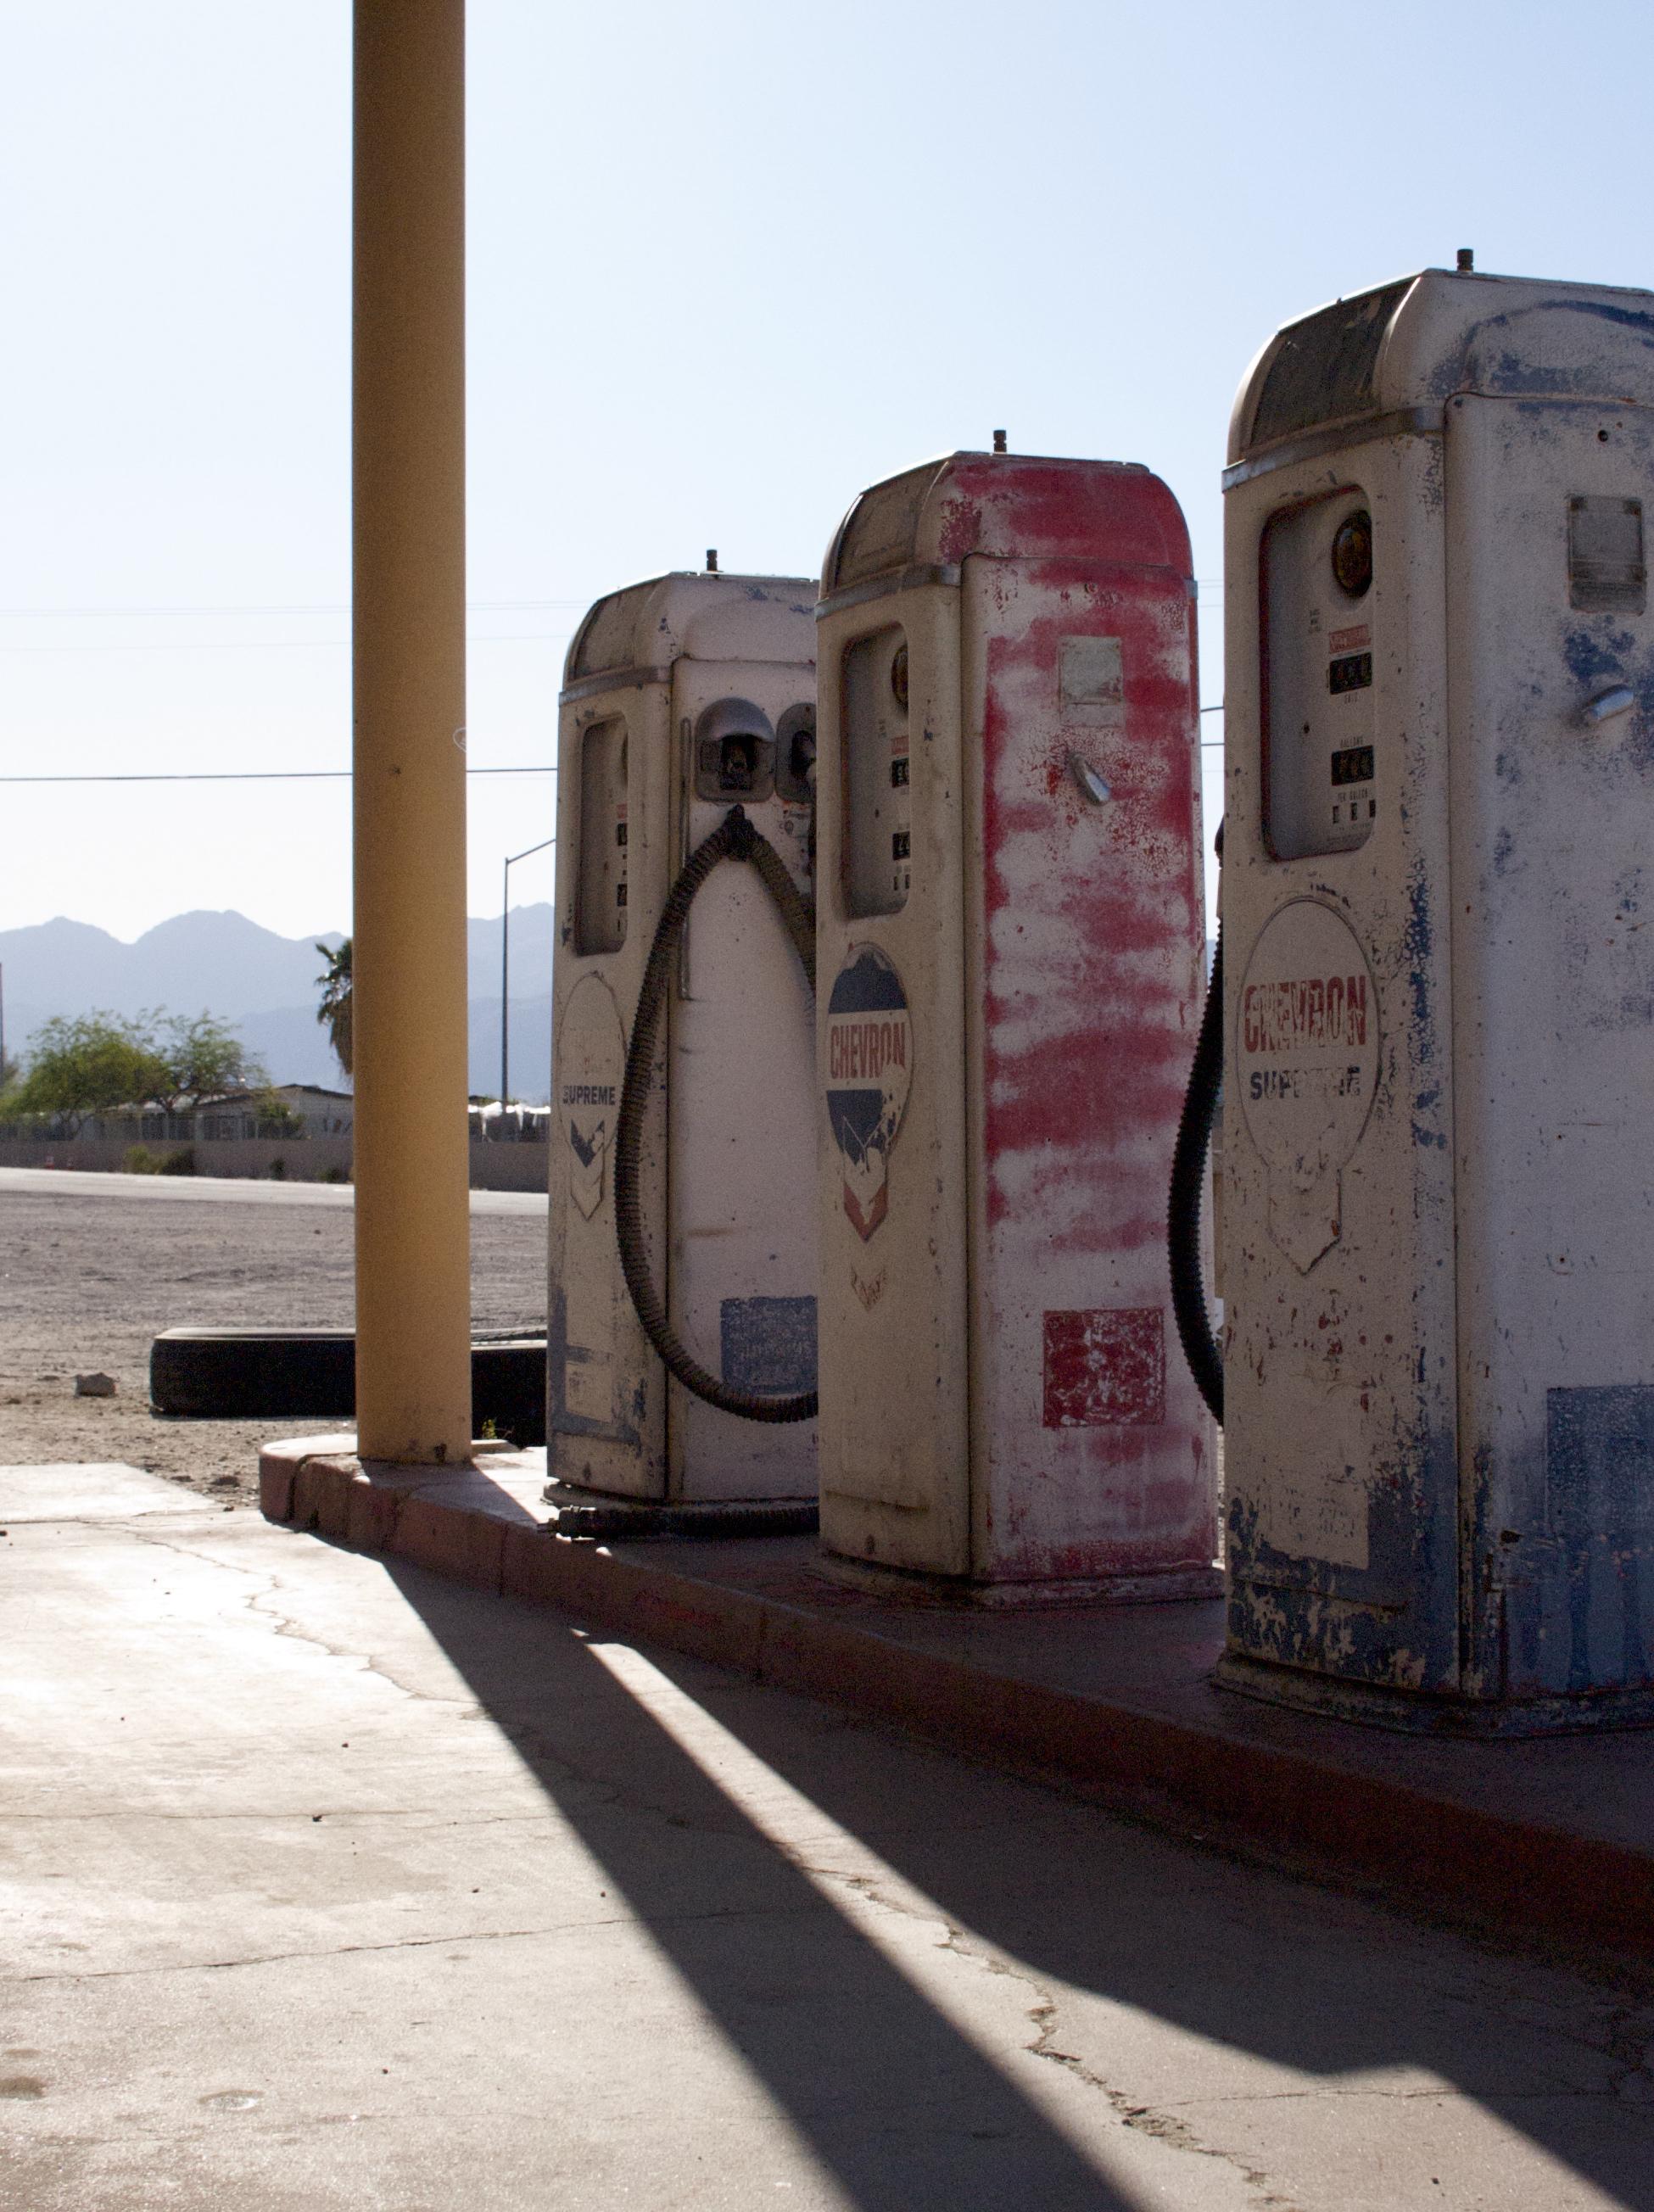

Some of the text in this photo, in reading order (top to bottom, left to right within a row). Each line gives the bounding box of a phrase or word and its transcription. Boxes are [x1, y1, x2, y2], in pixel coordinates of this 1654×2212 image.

[830, 1022, 906, 1079] CHEVRON
[563, 1085, 616, 1106] SUPREME
[1250, 1066, 1361, 1101] SUPE
